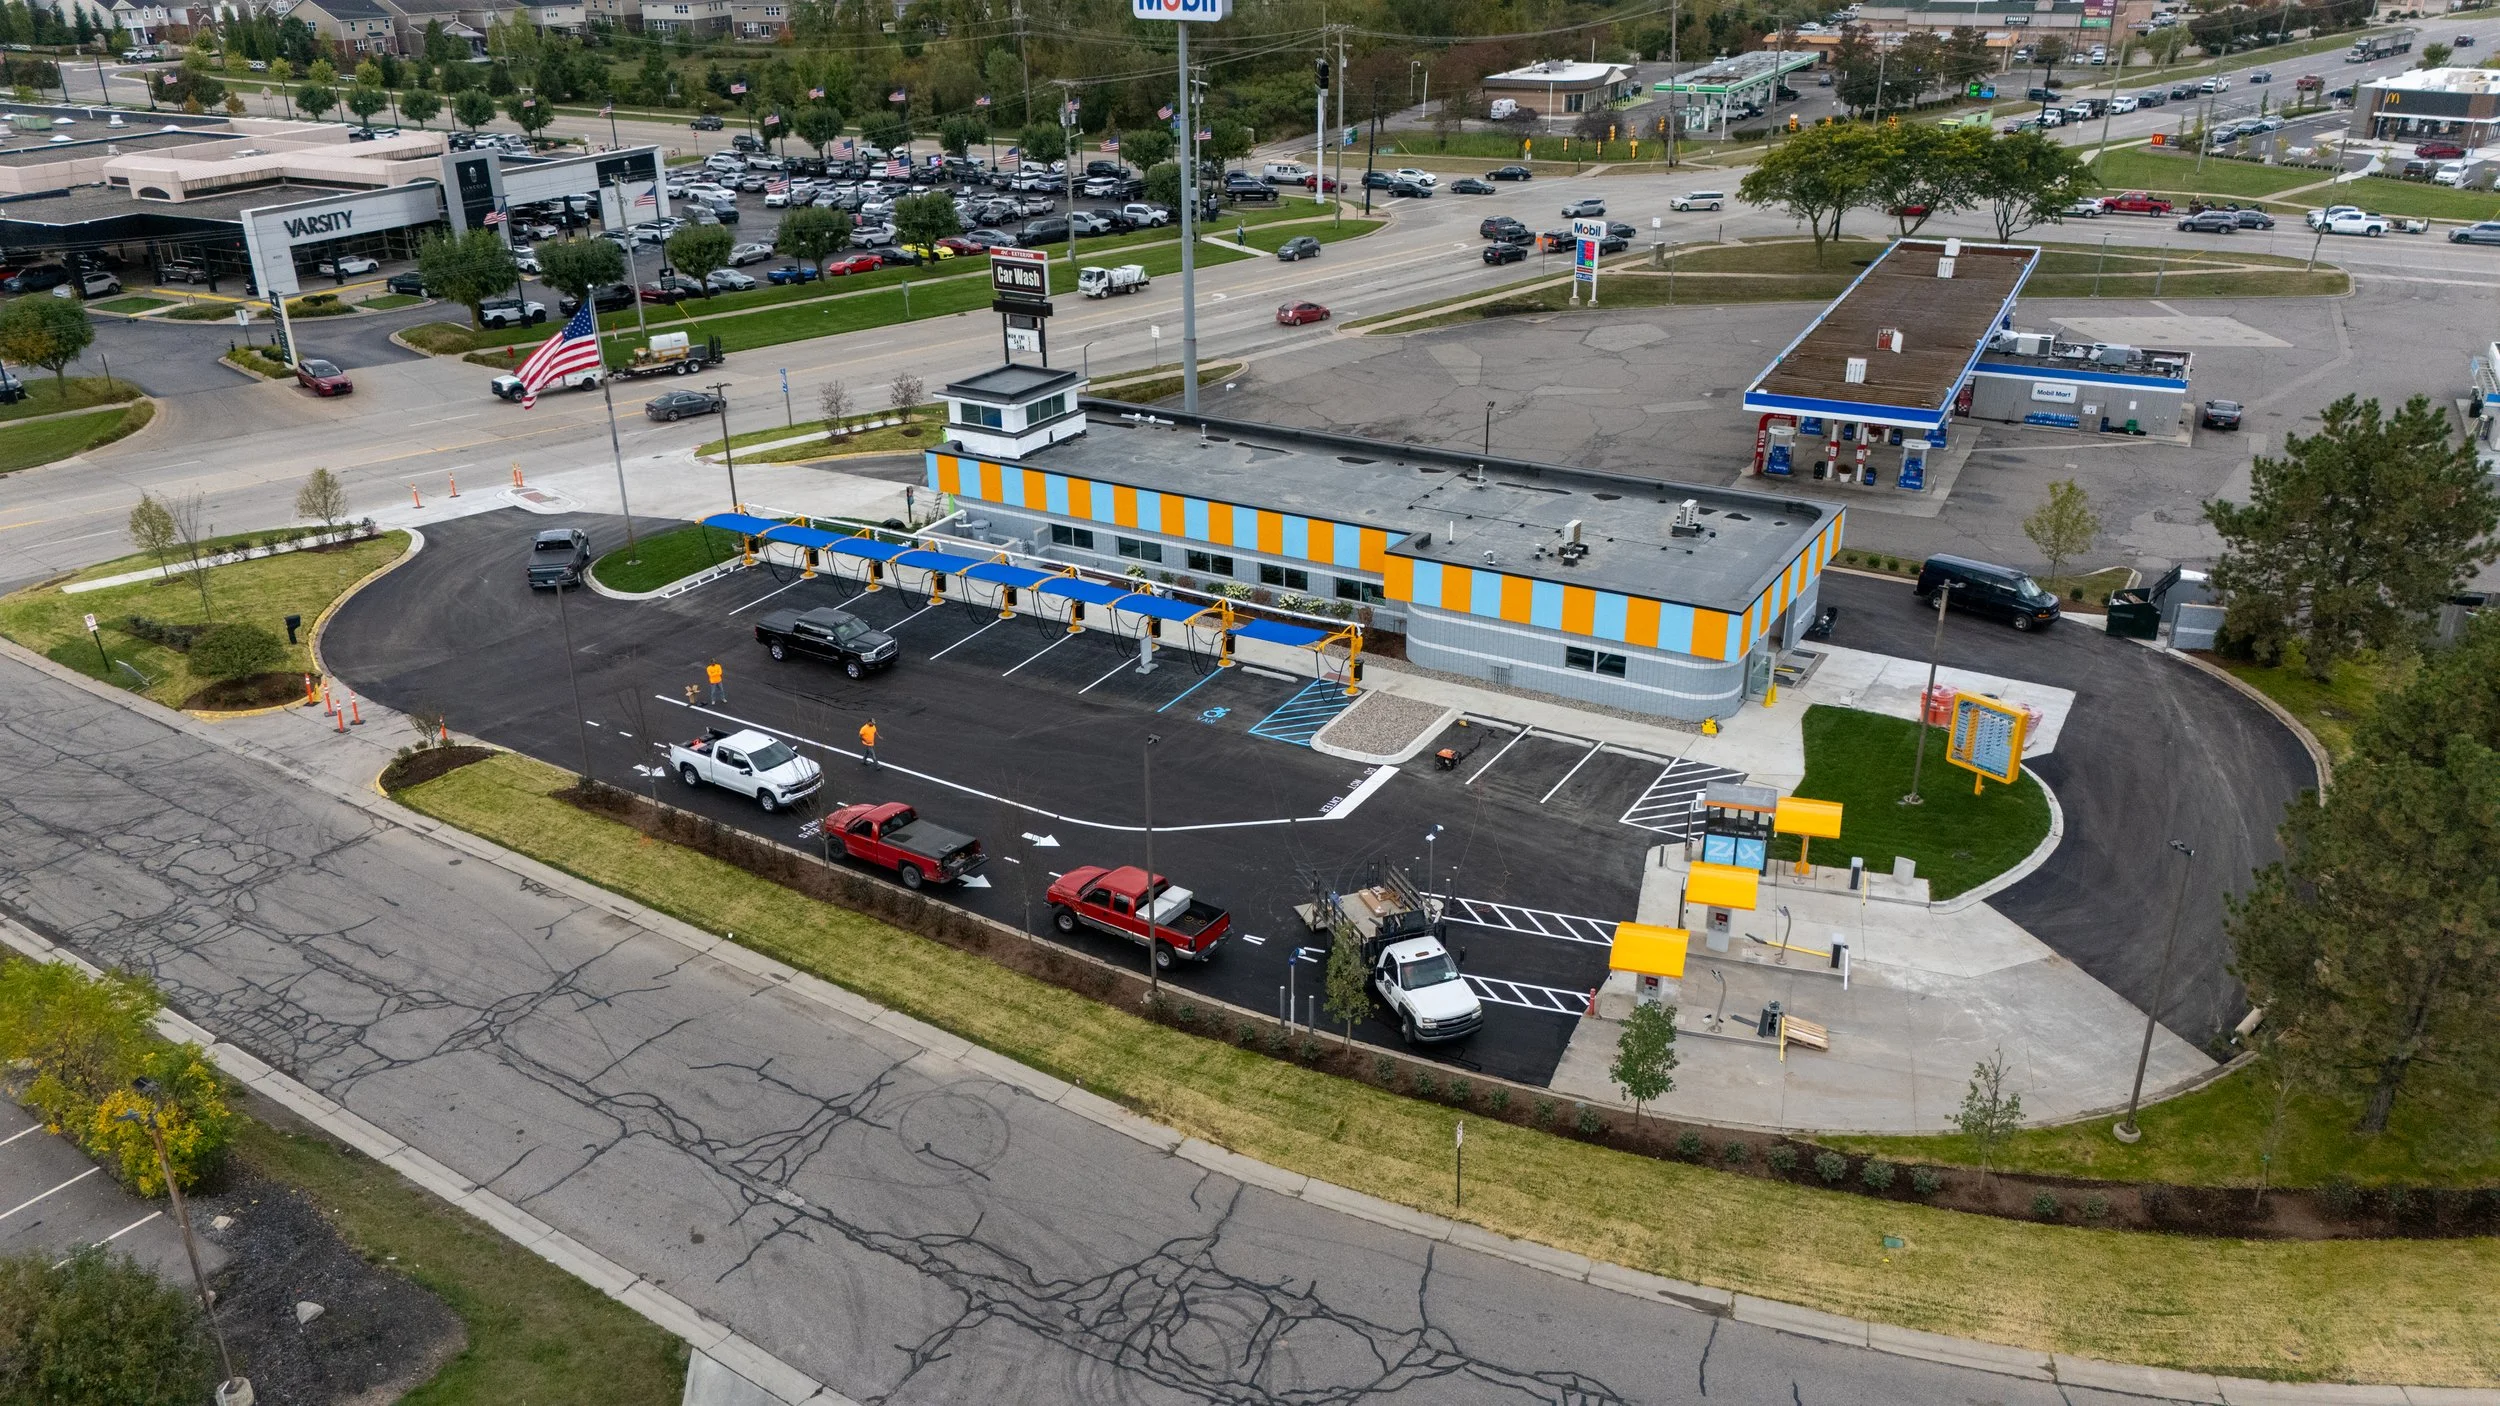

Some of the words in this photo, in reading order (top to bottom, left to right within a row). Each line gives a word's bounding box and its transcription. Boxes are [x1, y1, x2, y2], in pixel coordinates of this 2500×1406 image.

[283, 209, 353, 239] VARSITY
[1574, 222, 1601, 237] Mobil
[997, 265, 1013, 285] Car
[1013, 267, 1041, 287] Wash
[2036, 388, 2054, 397] Mobil
[1196, 715, 1217, 725] VAN
[1363, 767, 1377, 776] DO
[1347, 778, 1364, 790] NOT
[1319, 795, 1344, 813] ENTER
[1707, 840, 1762, 862] ZAX
